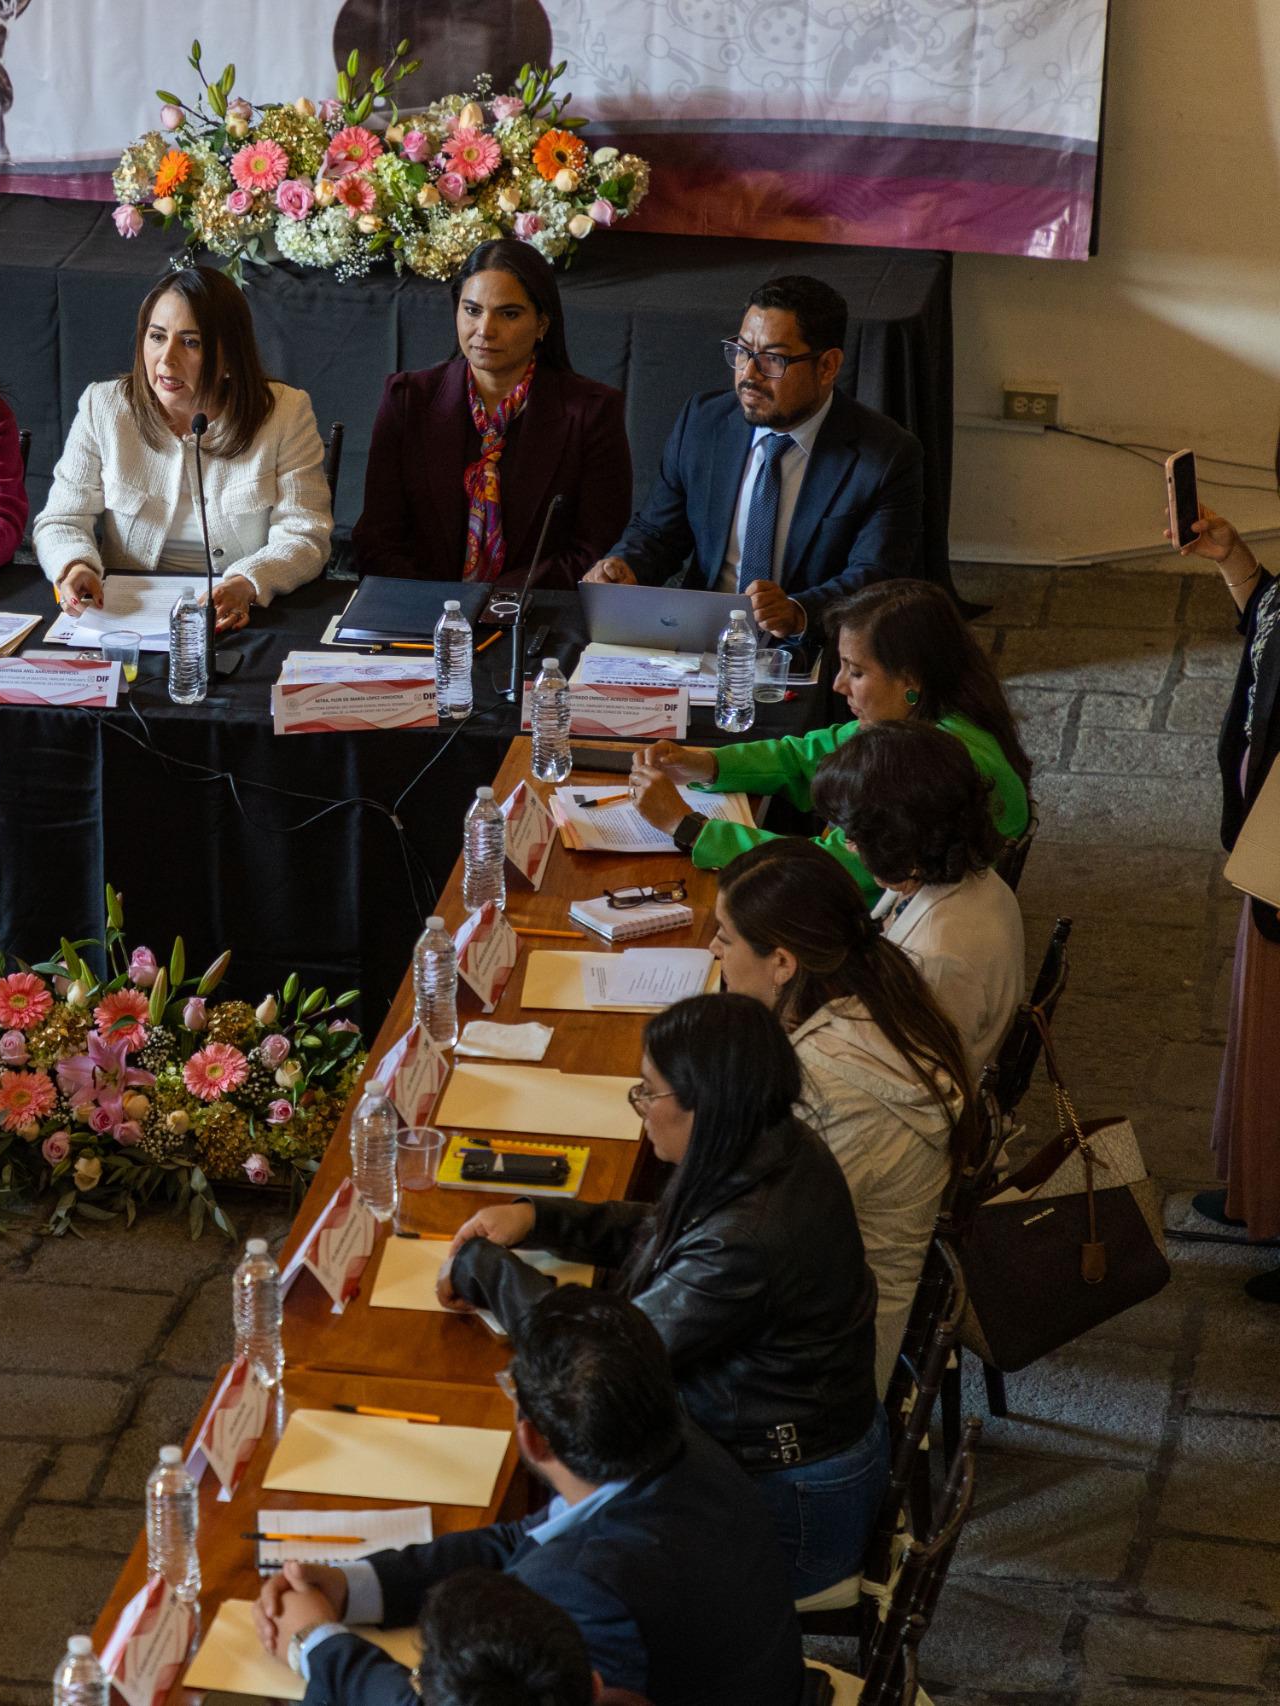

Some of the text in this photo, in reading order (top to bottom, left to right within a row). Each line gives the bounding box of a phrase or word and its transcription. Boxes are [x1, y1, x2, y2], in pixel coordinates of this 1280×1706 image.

[595, 680, 715, 688] ECONOCIMIENTO
[423, 692, 436, 700] DIF
[664, 703, 679, 711] DIF
